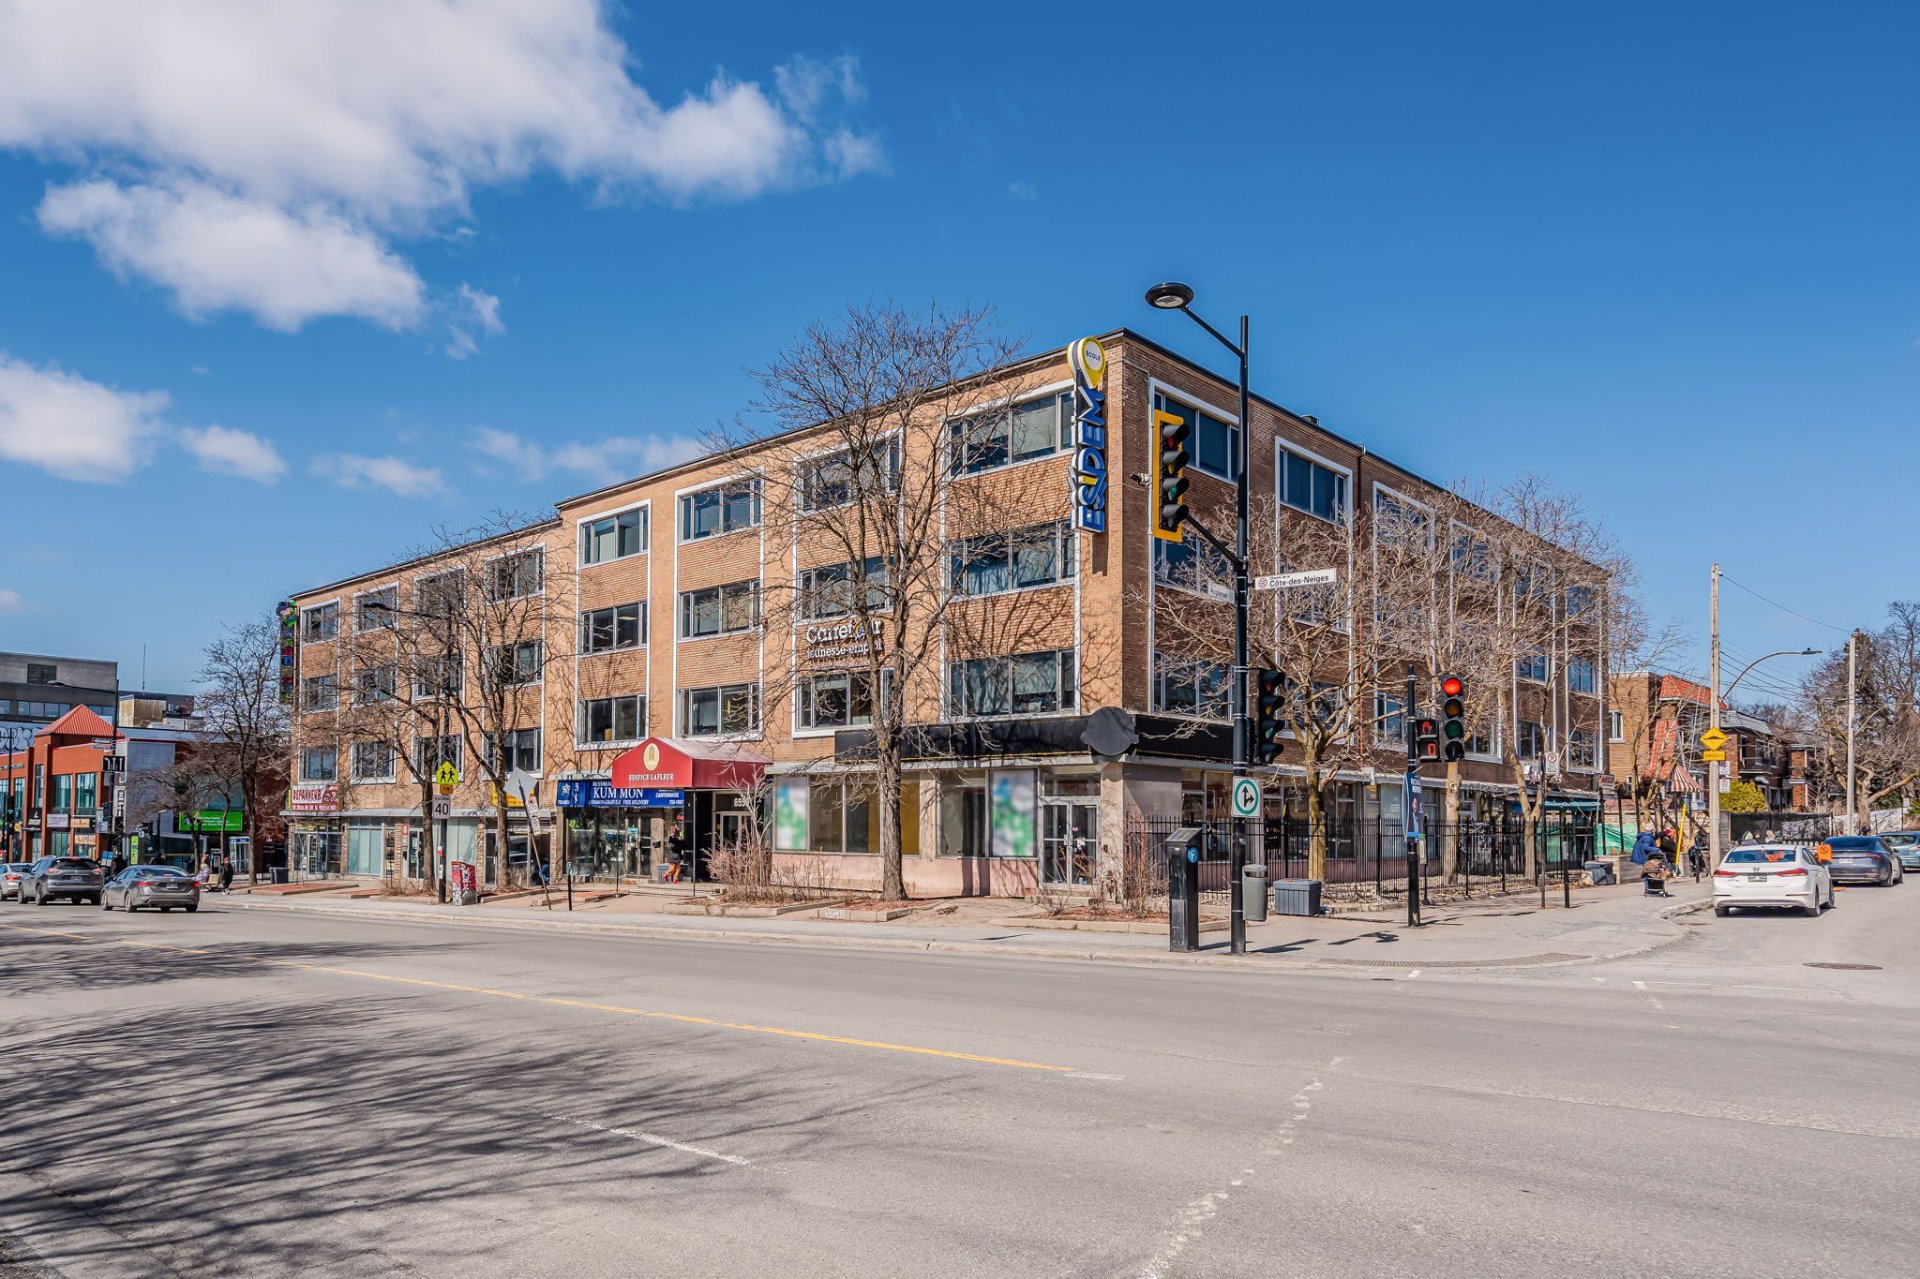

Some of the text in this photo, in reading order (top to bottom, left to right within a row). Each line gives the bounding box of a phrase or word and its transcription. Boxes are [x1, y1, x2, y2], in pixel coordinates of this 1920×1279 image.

[1269, 575, 1329, 588] Côte-des-Neiges
[593, 787, 617, 799] KUM
[620, 788, 644, 799] MON
[434, 803, 449, 816] 40
